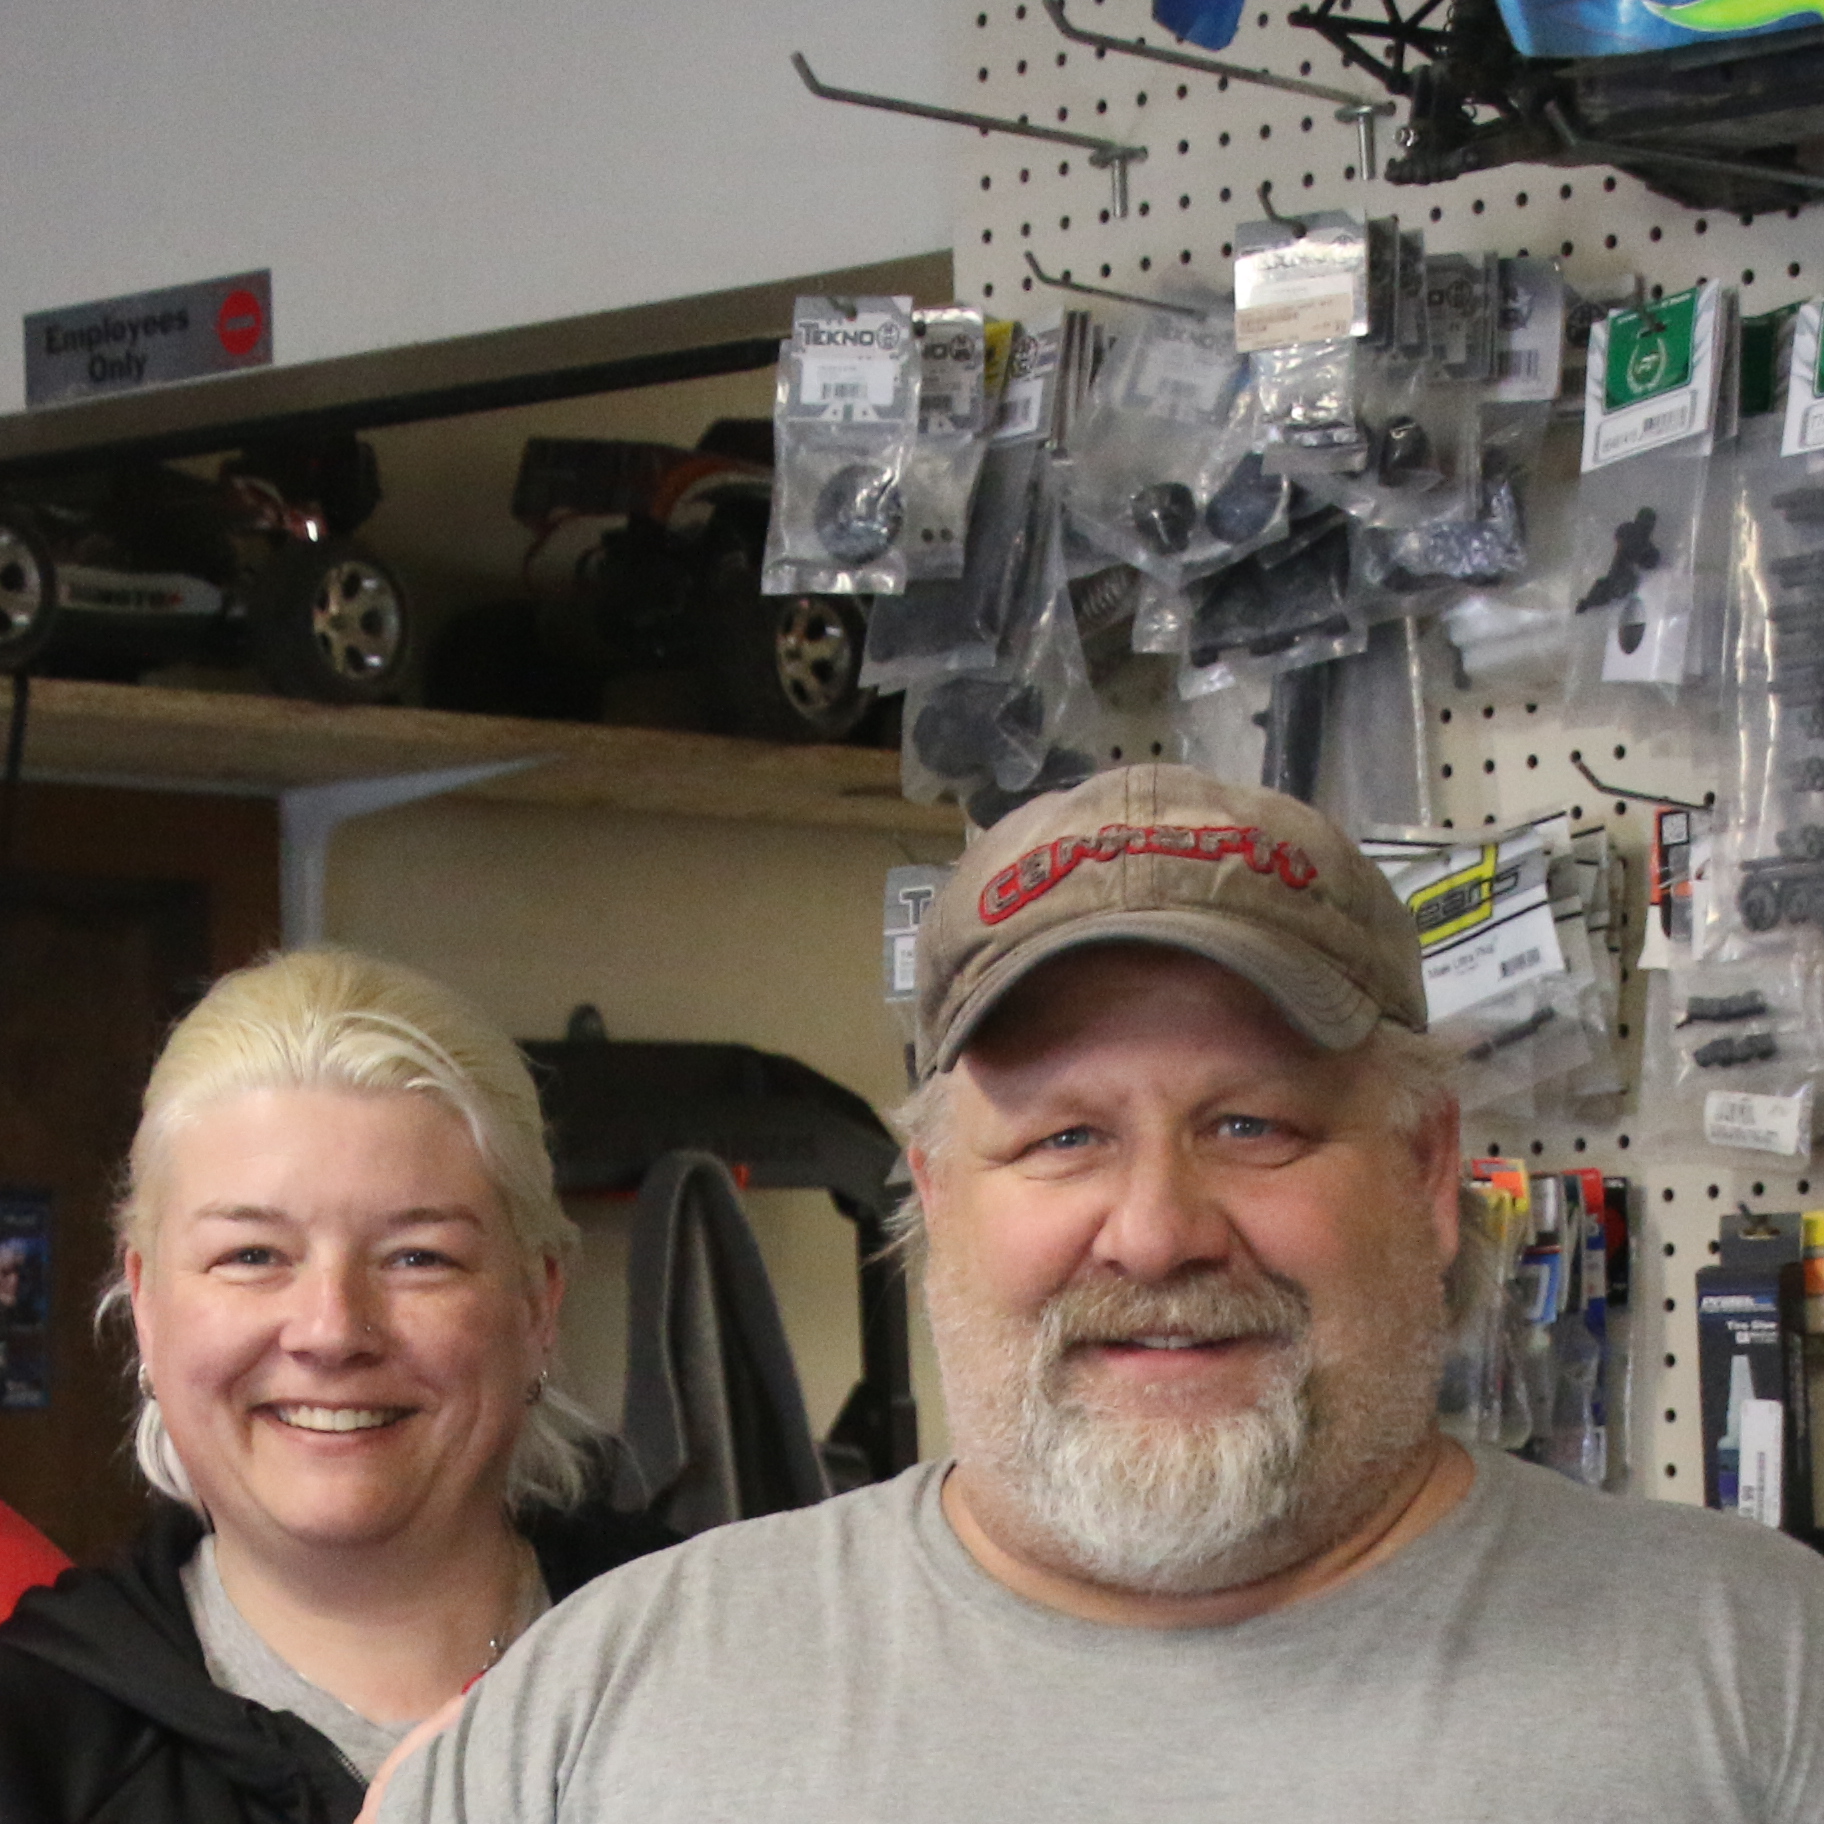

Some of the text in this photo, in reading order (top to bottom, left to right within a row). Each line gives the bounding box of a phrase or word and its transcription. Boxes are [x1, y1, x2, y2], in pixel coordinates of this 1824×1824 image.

[44, 307, 189, 356] Employees
[798, 322, 875, 347] TEKNO
[87, 353, 147, 384] Only
